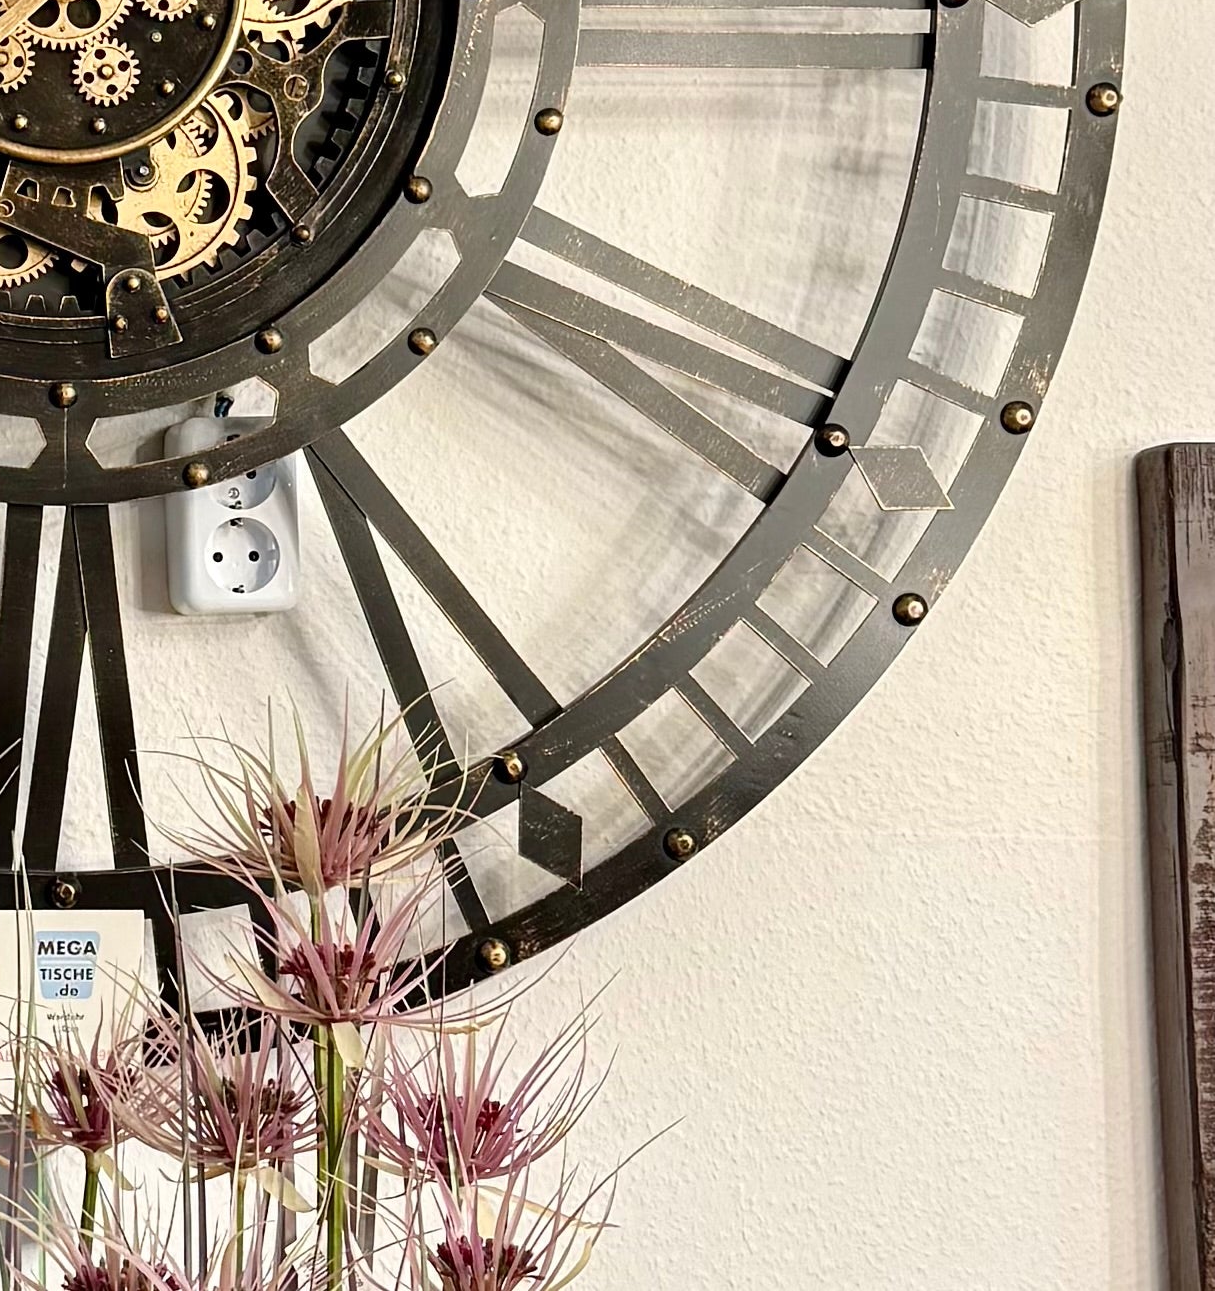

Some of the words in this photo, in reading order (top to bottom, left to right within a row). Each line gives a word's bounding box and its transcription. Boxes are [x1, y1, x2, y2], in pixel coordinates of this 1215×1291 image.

[301, 427, 564, 783] V
[37, 940, 97, 956] MEGA
[40, 968, 94, 981] TISCHE
[55, 984, 79, 997] .de
